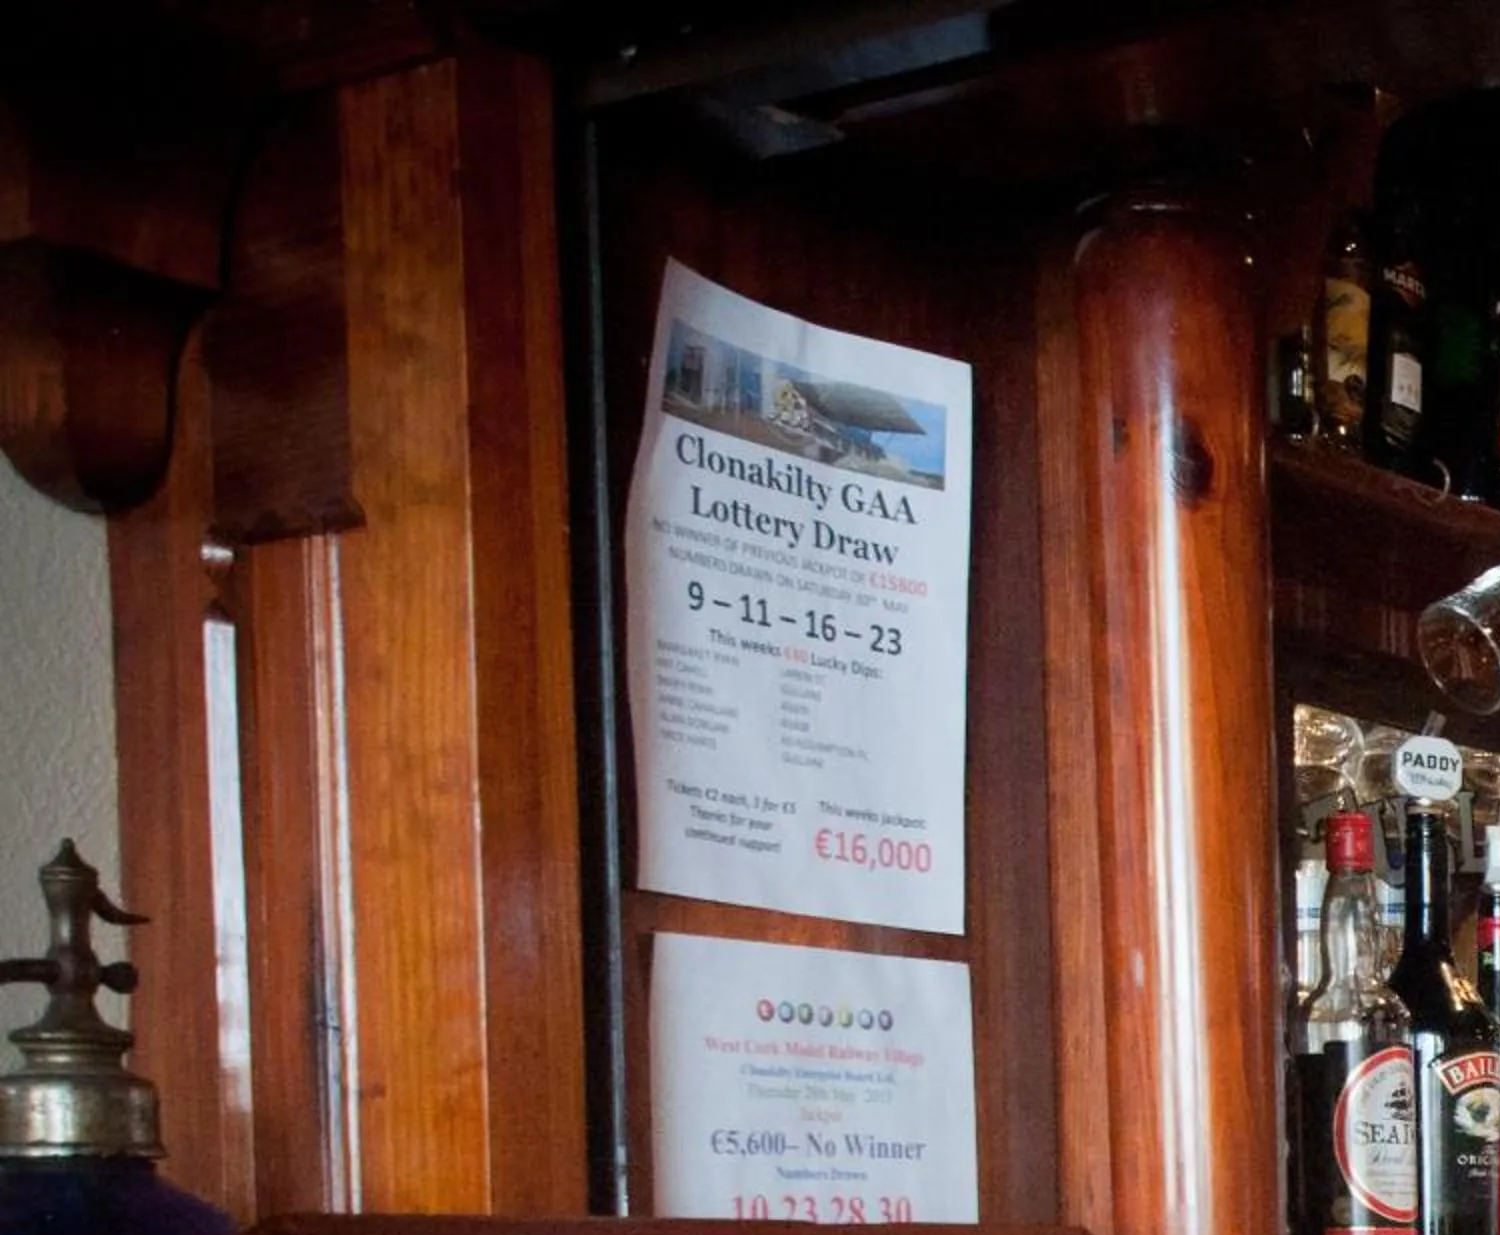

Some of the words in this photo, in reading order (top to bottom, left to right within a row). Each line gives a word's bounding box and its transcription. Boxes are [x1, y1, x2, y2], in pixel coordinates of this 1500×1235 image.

[676, 432, 833, 510] Clonakilty
[841, 483, 920, 526] GAA
[690, 485, 806, 548] Lottery
[814, 519, 900, 566] Draw
[801, 558, 848, 582] JACKPOT
[688, 580, 705, 611] 9
[740, 594, 772, 628] 11
[805, 610, 837, 642] 16
[869, 625, 903, 656] 23
[709, 629, 738, 648] This
[811, 651, 849, 676] Lucky
[1401, 750, 1460, 773] PADDY
[813, 827, 933, 873] €16,000
[805, 1133, 836, 1158] No
[843, 1134, 927, 1161] Winner
[732, 1193, 769, 1220] 10
[783, 1195, 818, 1223] 23
[880, 1195, 912, 1223] 30
